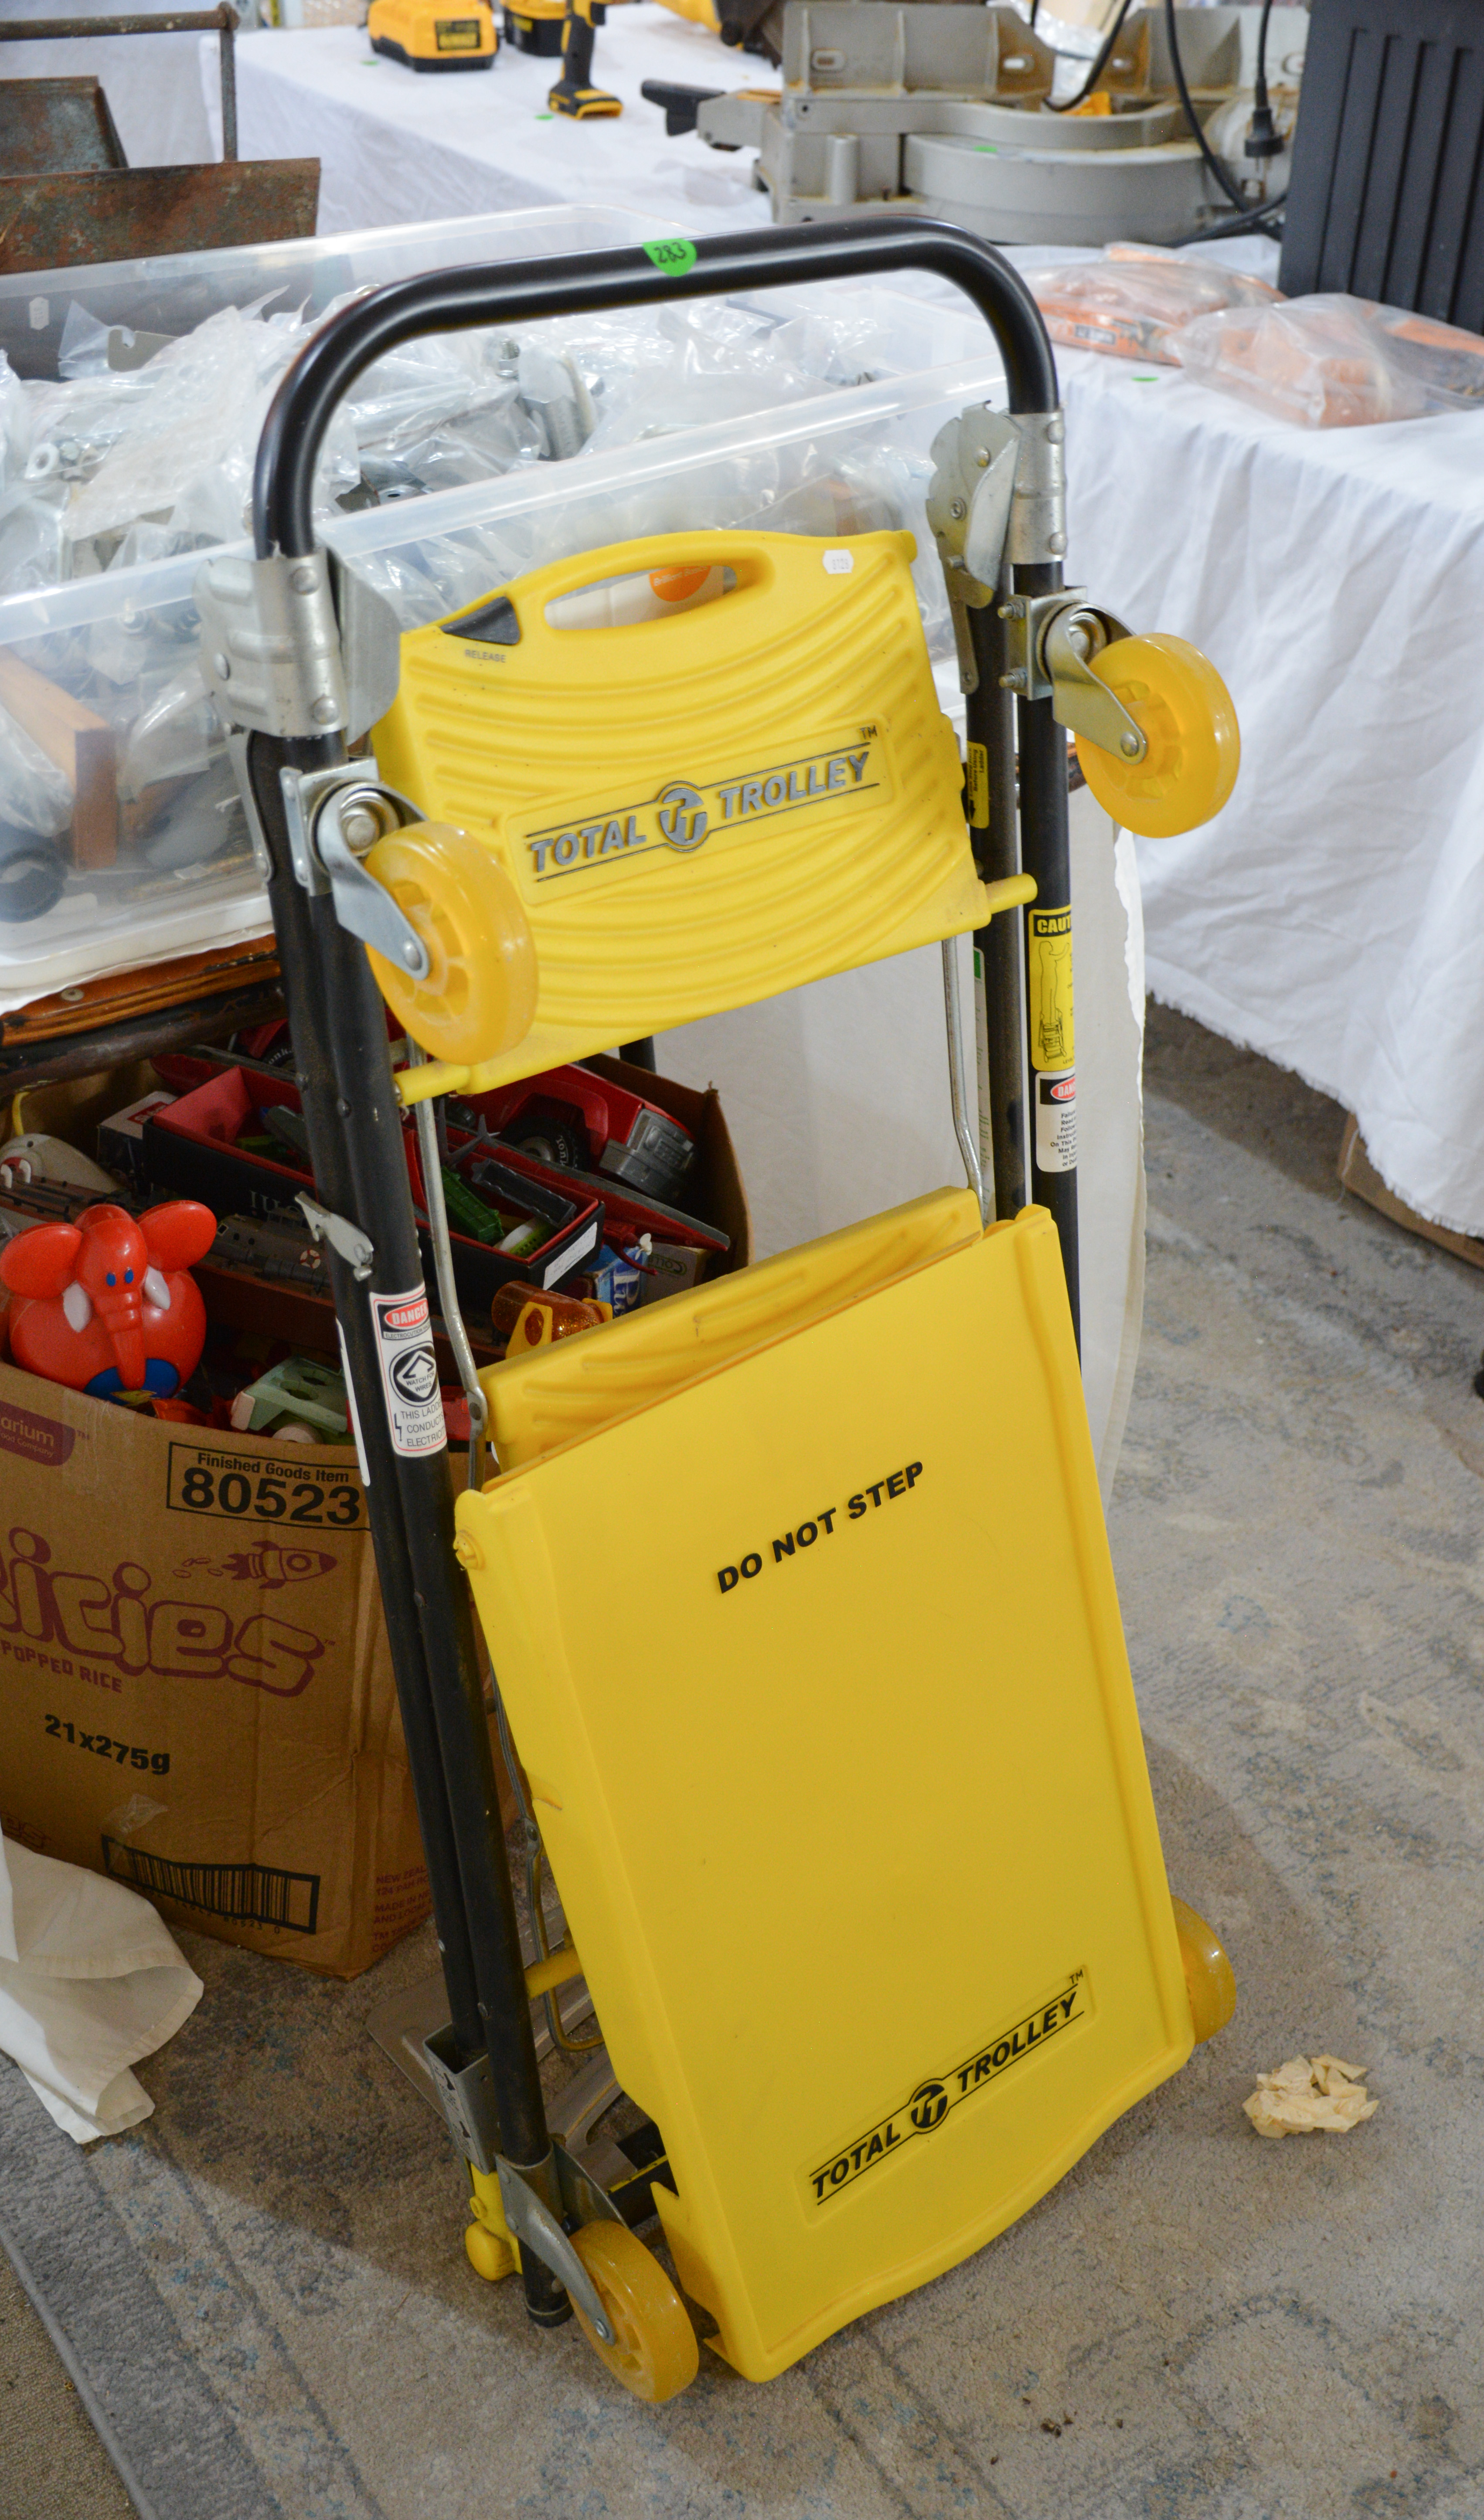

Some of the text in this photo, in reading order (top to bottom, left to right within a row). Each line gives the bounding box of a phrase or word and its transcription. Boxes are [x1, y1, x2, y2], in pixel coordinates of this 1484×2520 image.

[654, 241, 687, 263] 283
[465, 649, 507, 663] RELEASE
[531, 815, 647, 873] TOTAL
[719, 751, 870, 820] TROLLEY
[406, 1371, 435, 1386] WATCH FOR
[415, 1381, 432, 1392] WIRES
[401, 1410, 420, 1420] THIS
[17, 1438, 54, 1458] Company
[197, 1452, 349, 1483] Finished Goods Item
[181, 1467, 360, 1525] 80523
[717, 1461, 923, 1594] DO NOT STEP
[0, 1639, 123, 1694] POPPED RICE
[44, 1714, 170, 1776] 21x275g
[376, 1874, 401, 1884] NEW
[374, 1900, 405, 1912] MADE
[374, 1915, 396, 1924] AND
[812, 2123, 901, 2199] TOTAL
[957, 1991, 1077, 2093] TROLLEY
